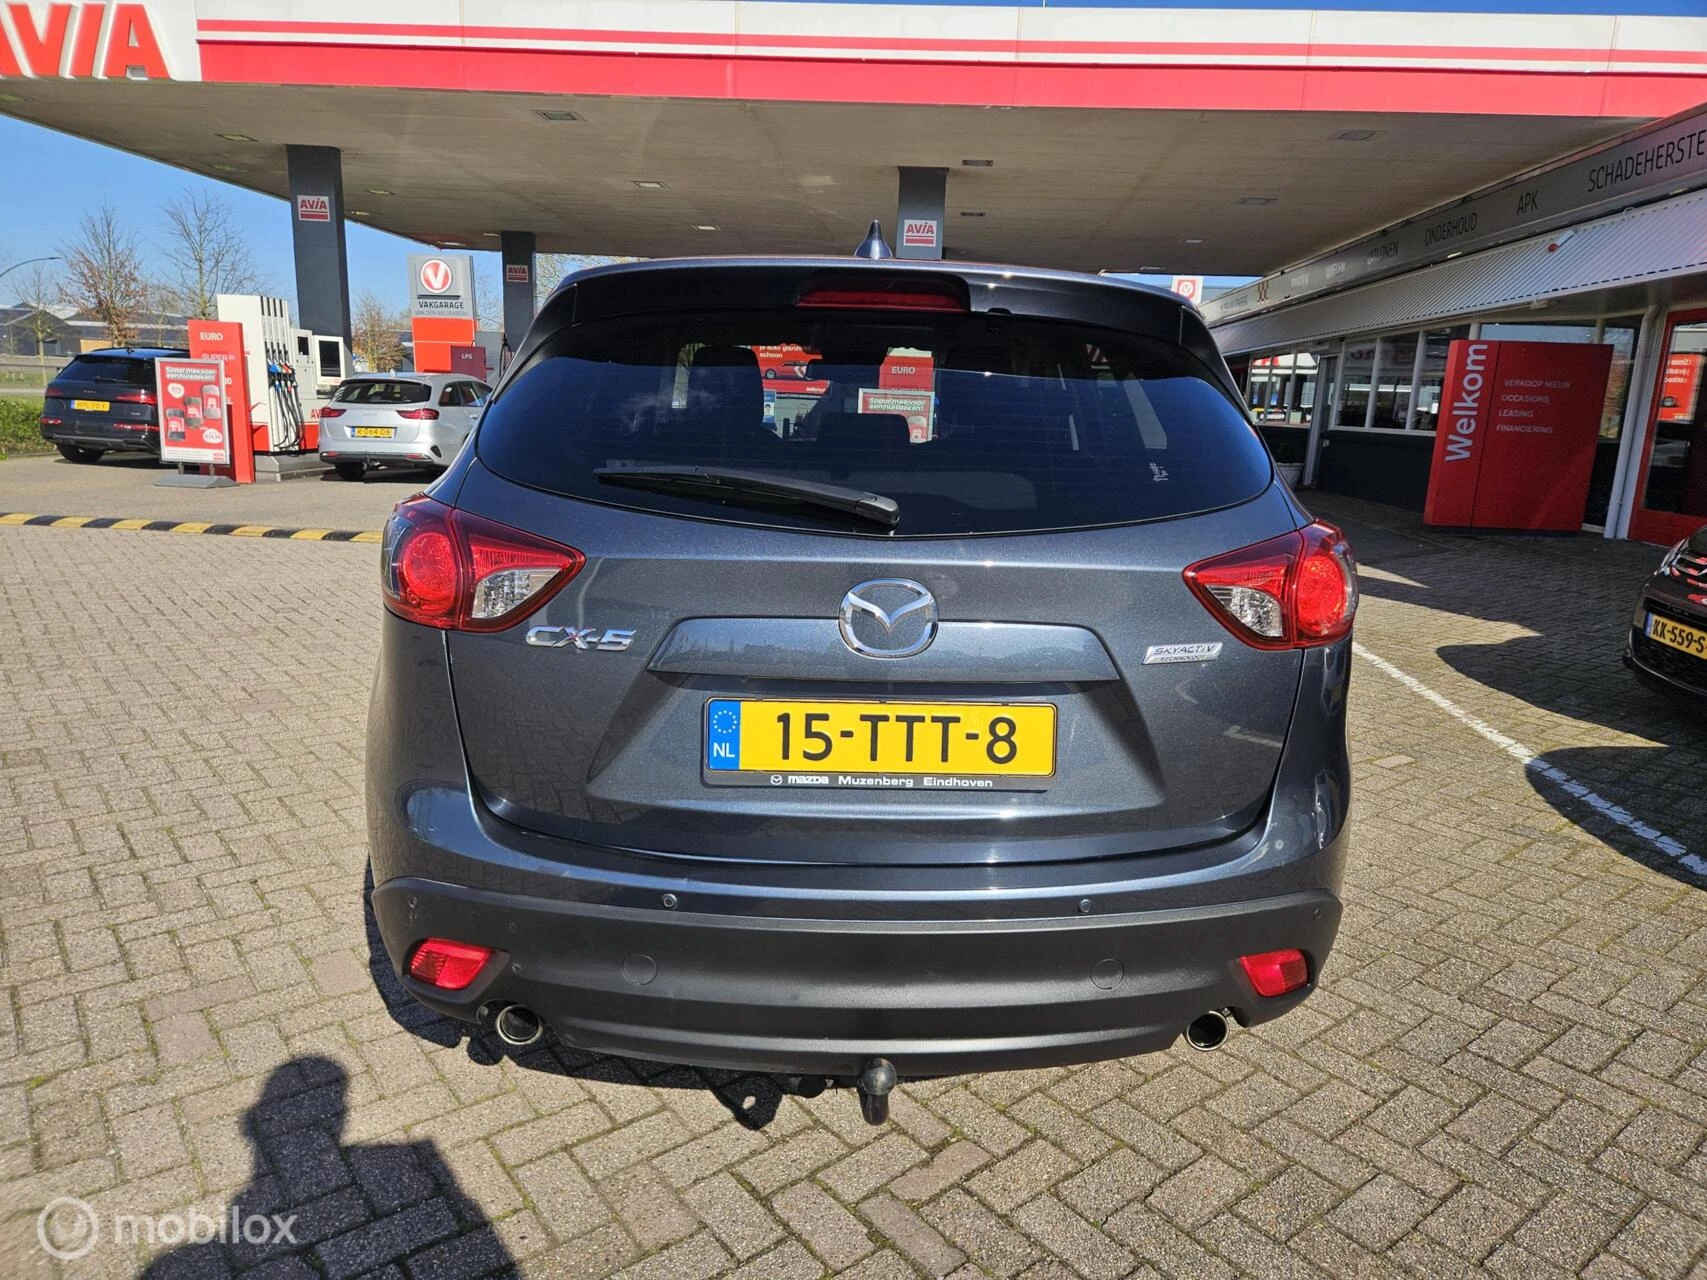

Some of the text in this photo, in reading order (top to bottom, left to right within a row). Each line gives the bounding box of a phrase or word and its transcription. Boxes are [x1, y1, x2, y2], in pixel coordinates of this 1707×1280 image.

[1588, 129, 1707, 193] SCHADEHERSTE
[300, 198, 328, 210] AVIA
[1517, 190, 1539, 215] APK
[906, 221, 935, 234] AVIA
[1425, 211, 1478, 246] ONDERHOUD
[418, 301, 465, 309] VAKGARAGE
[200, 332, 223, 341] EURO
[891, 366, 916, 374] EURO
[1504, 378, 1571, 389] VERKOOP NIEUW
[1445, 344, 1489, 462] Welkom
[1501, 394, 1550, 404] OCCASIONS
[1498, 409, 1534, 418] LEASING
[1496, 424, 1553, 433] FINANCIERING
[525, 626, 638, 652] CX-5
[1653, 618, 1706, 654] KK-559-S
[1154, 644, 1216, 656] SKYACTIV
[777, 712, 1018, 765] 15-TTT-8
[713, 742, 736, 759] NL
[838, 775, 914, 788] Muzenberg
[923, 776, 993, 788] Eindhoven
